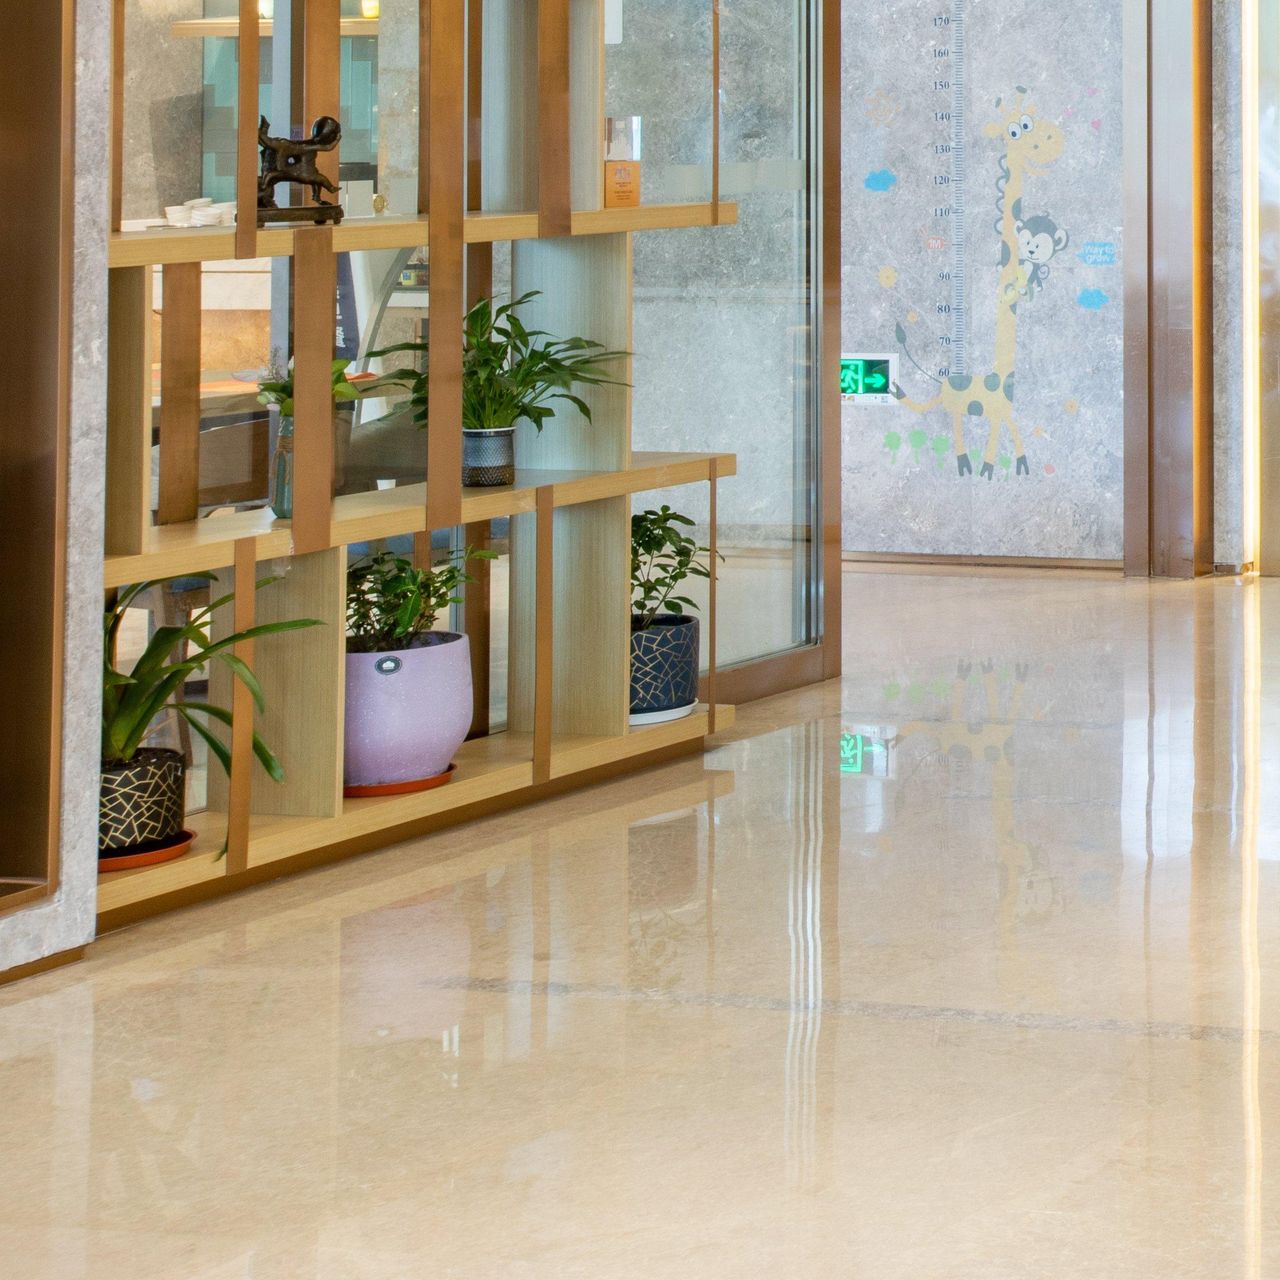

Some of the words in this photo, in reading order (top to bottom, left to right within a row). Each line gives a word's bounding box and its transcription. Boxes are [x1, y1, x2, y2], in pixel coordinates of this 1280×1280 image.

[933, 16, 950, 26] 170
[933, 48, 949, 58] 160
[934, 81, 950, 90] 150
[934, 112, 951, 121] 140
[934, 144, 951, 154] 130
[933, 175, 950, 185] 120
[933, 207, 950, 217] 110
[939, 271, 951, 281] 90
[937, 304, 951, 313] 80
[939, 336, 951, 346] 70
[938, 367, 950, 377] 60
